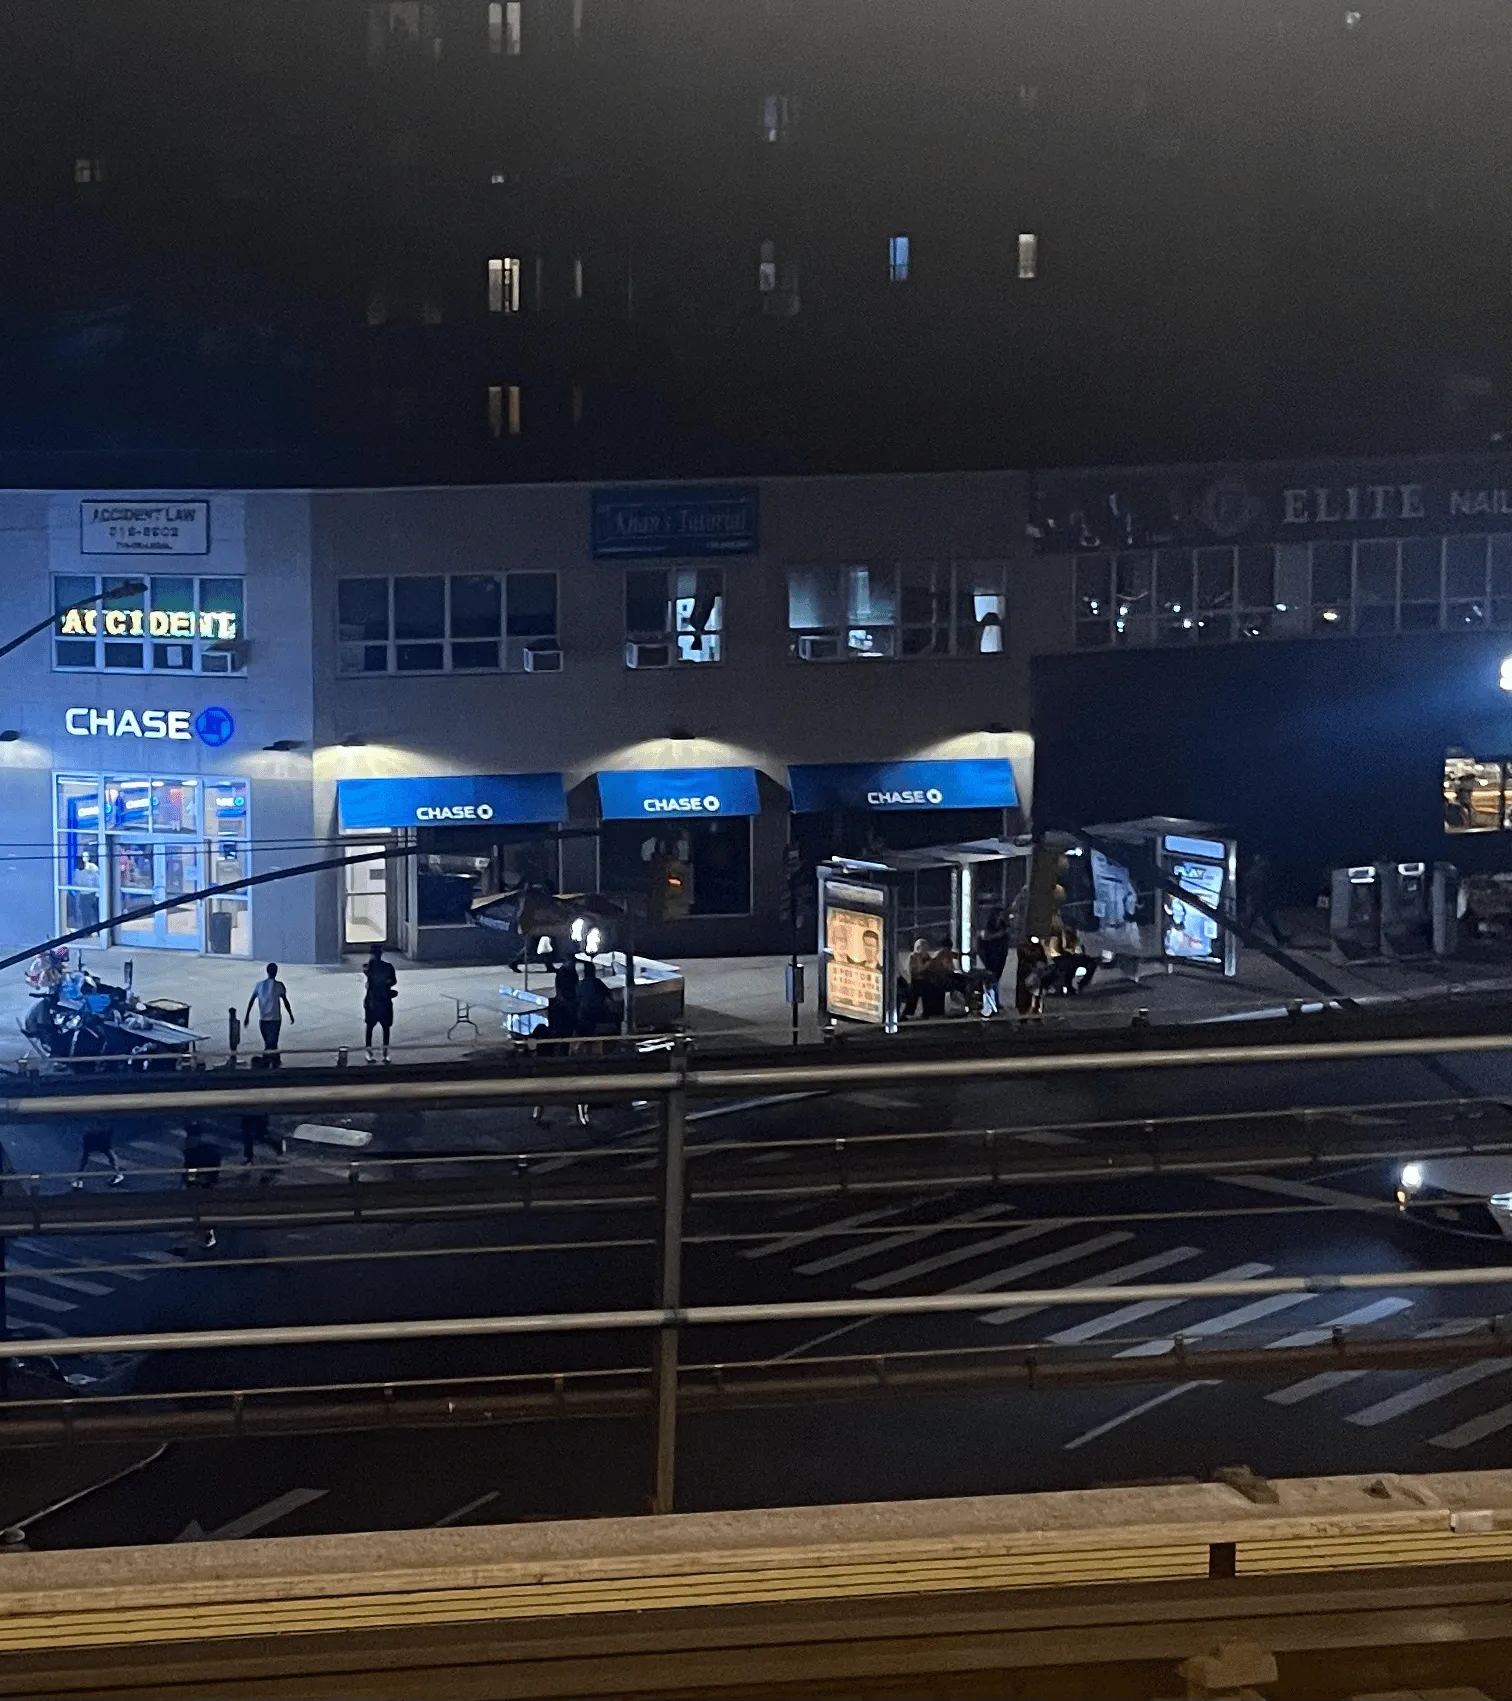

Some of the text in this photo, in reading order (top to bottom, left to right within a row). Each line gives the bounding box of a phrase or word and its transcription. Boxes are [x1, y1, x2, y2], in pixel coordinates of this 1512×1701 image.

[1283, 483, 1425, 523] ELITE
[165, 507, 196, 522] LAW
[61, 608, 236, 640] ACCIDENT
[65, 706, 192, 740] CHASE
[643, 797, 703, 811] CHASE
[868, 790, 926, 804] CHASE
[416, 805, 476, 820] CHASE
